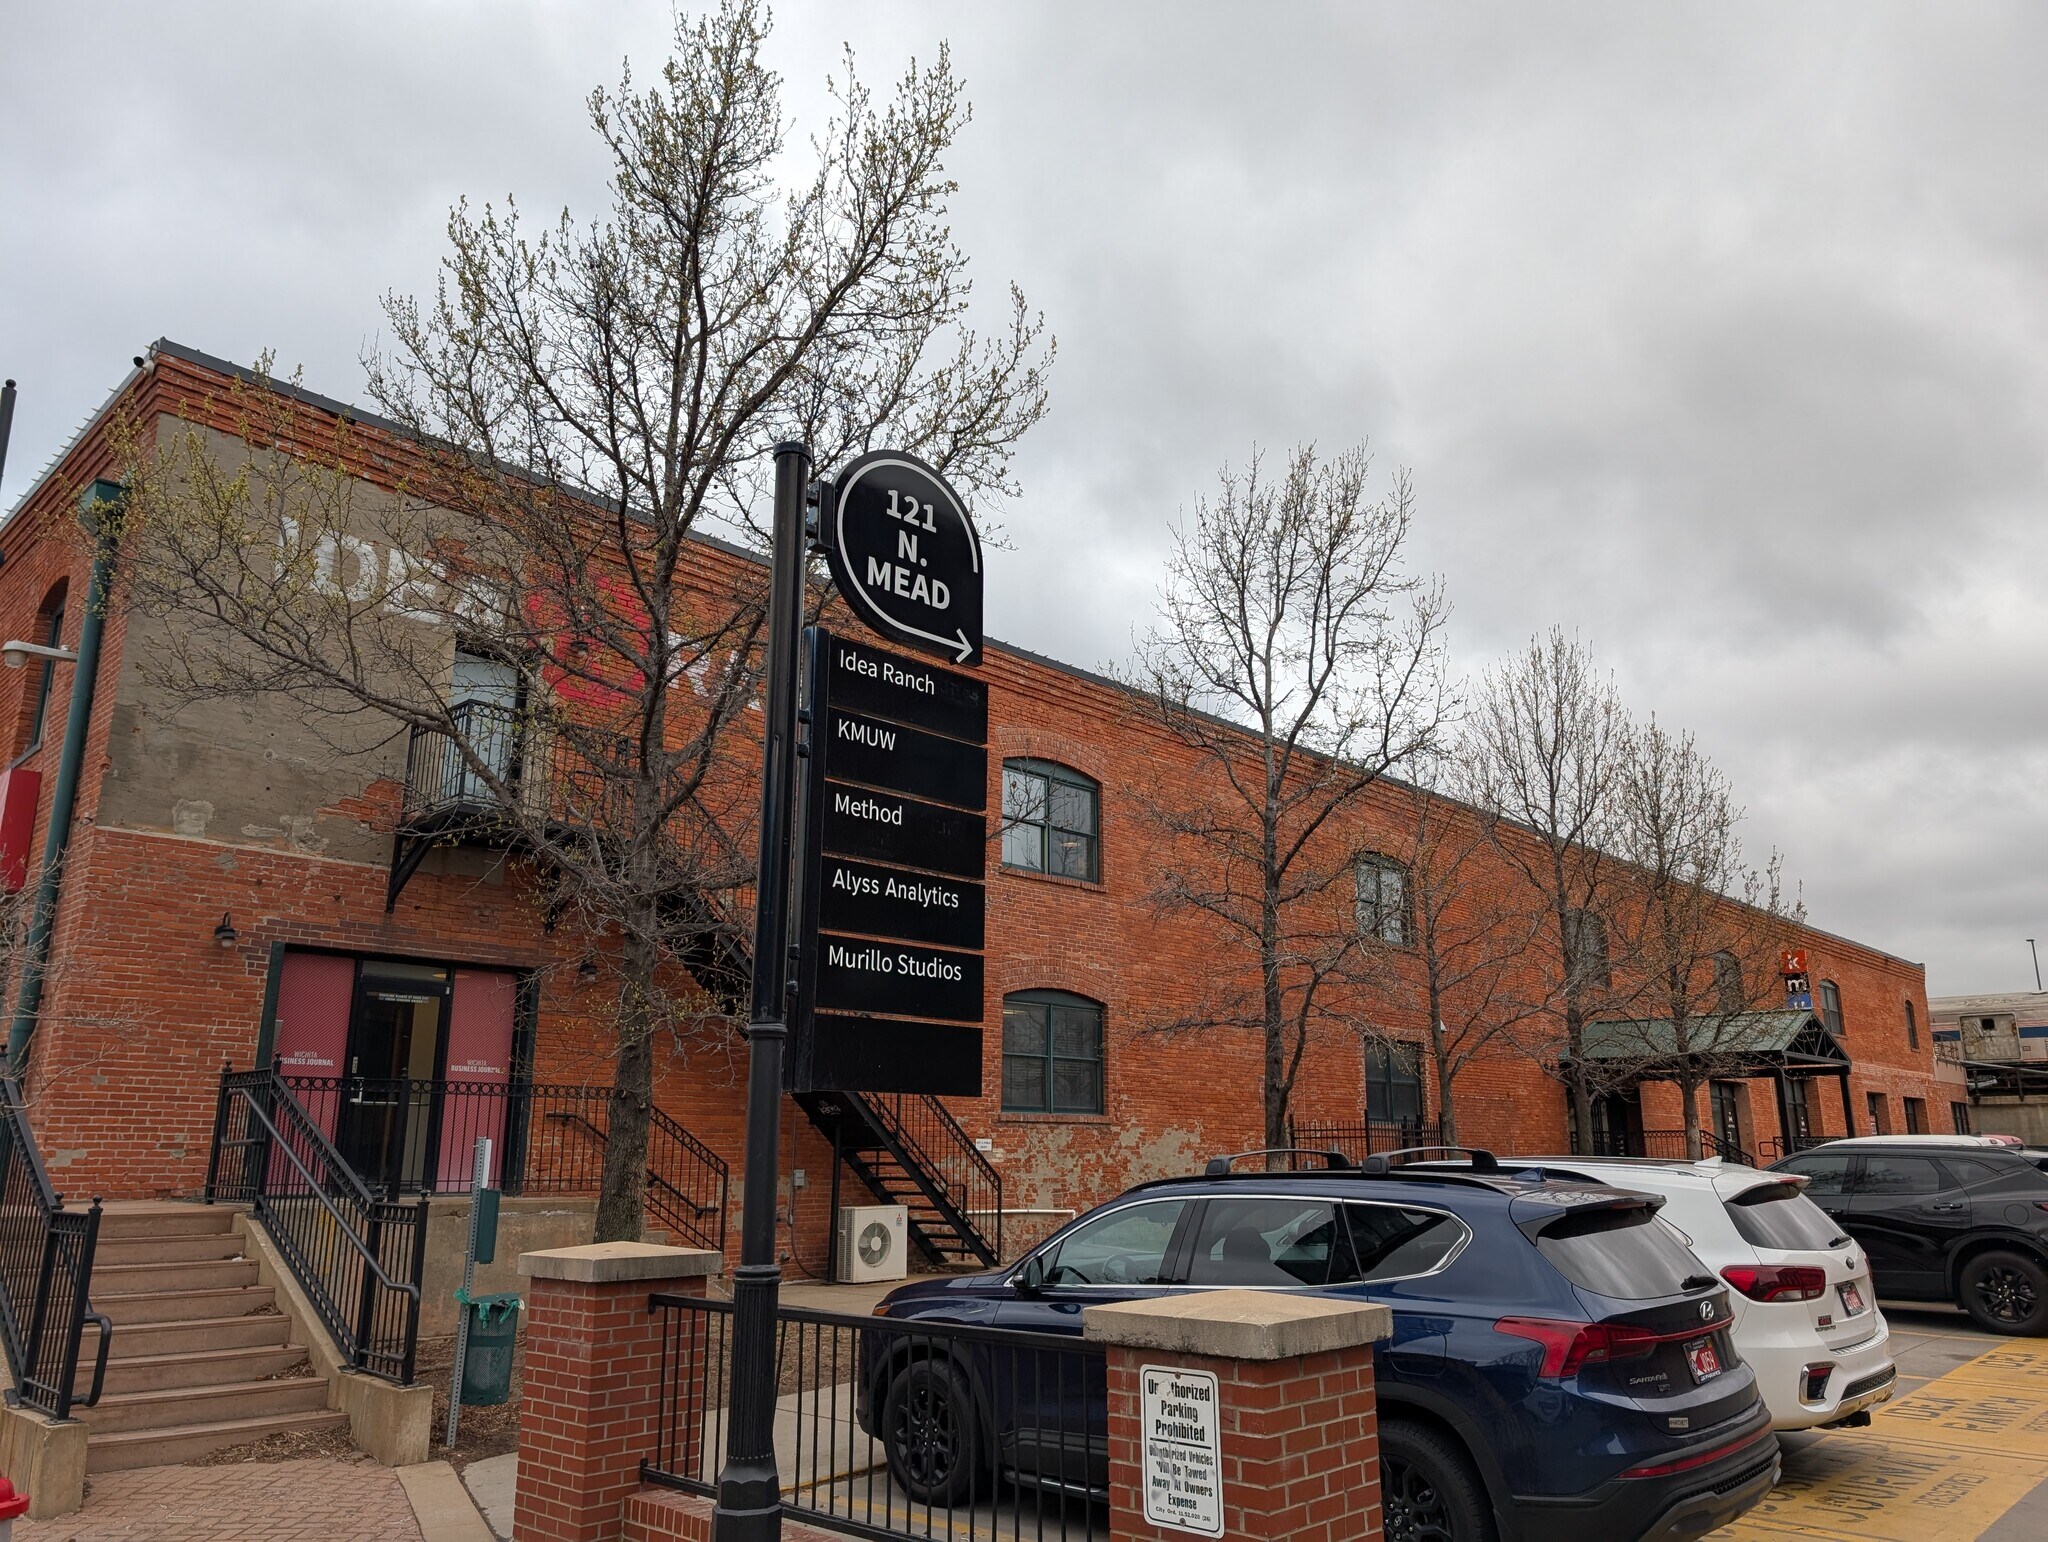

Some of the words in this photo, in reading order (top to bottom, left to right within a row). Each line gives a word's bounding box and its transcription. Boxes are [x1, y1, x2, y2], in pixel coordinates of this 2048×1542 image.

[886, 489, 937, 534] 121
[898, 529, 928, 567] N.
[867, 556, 951, 610] MEAD
[839, 649, 878, 678] Idea
[883, 663, 936, 695] Ranch
[837, 718, 896, 751] KMUW
[834, 793, 903, 826] Method
[832, 868, 880, 895] Alyss
[885, 877, 960, 909] Analytics
[828, 945, 893, 974] Murillo
[897, 954, 962, 982] Studios
[1161, 1400, 1198, 1423] Parking
[1155, 1419, 1205, 1442] Prohibited
[1172, 1463, 1181, 1476] Be
[1184, 1465, 1207, 1480] Towed
[1188, 1450, 1214, 1466] Vehicles
[1152, 1475, 1170, 1491] Away
[1174, 1479, 1182, 1491] At
[1184, 1481, 1213, 1498] Owners
[1168, 1493, 1197, 1510] Expense
[1155, 1506, 1165, 1514] City
